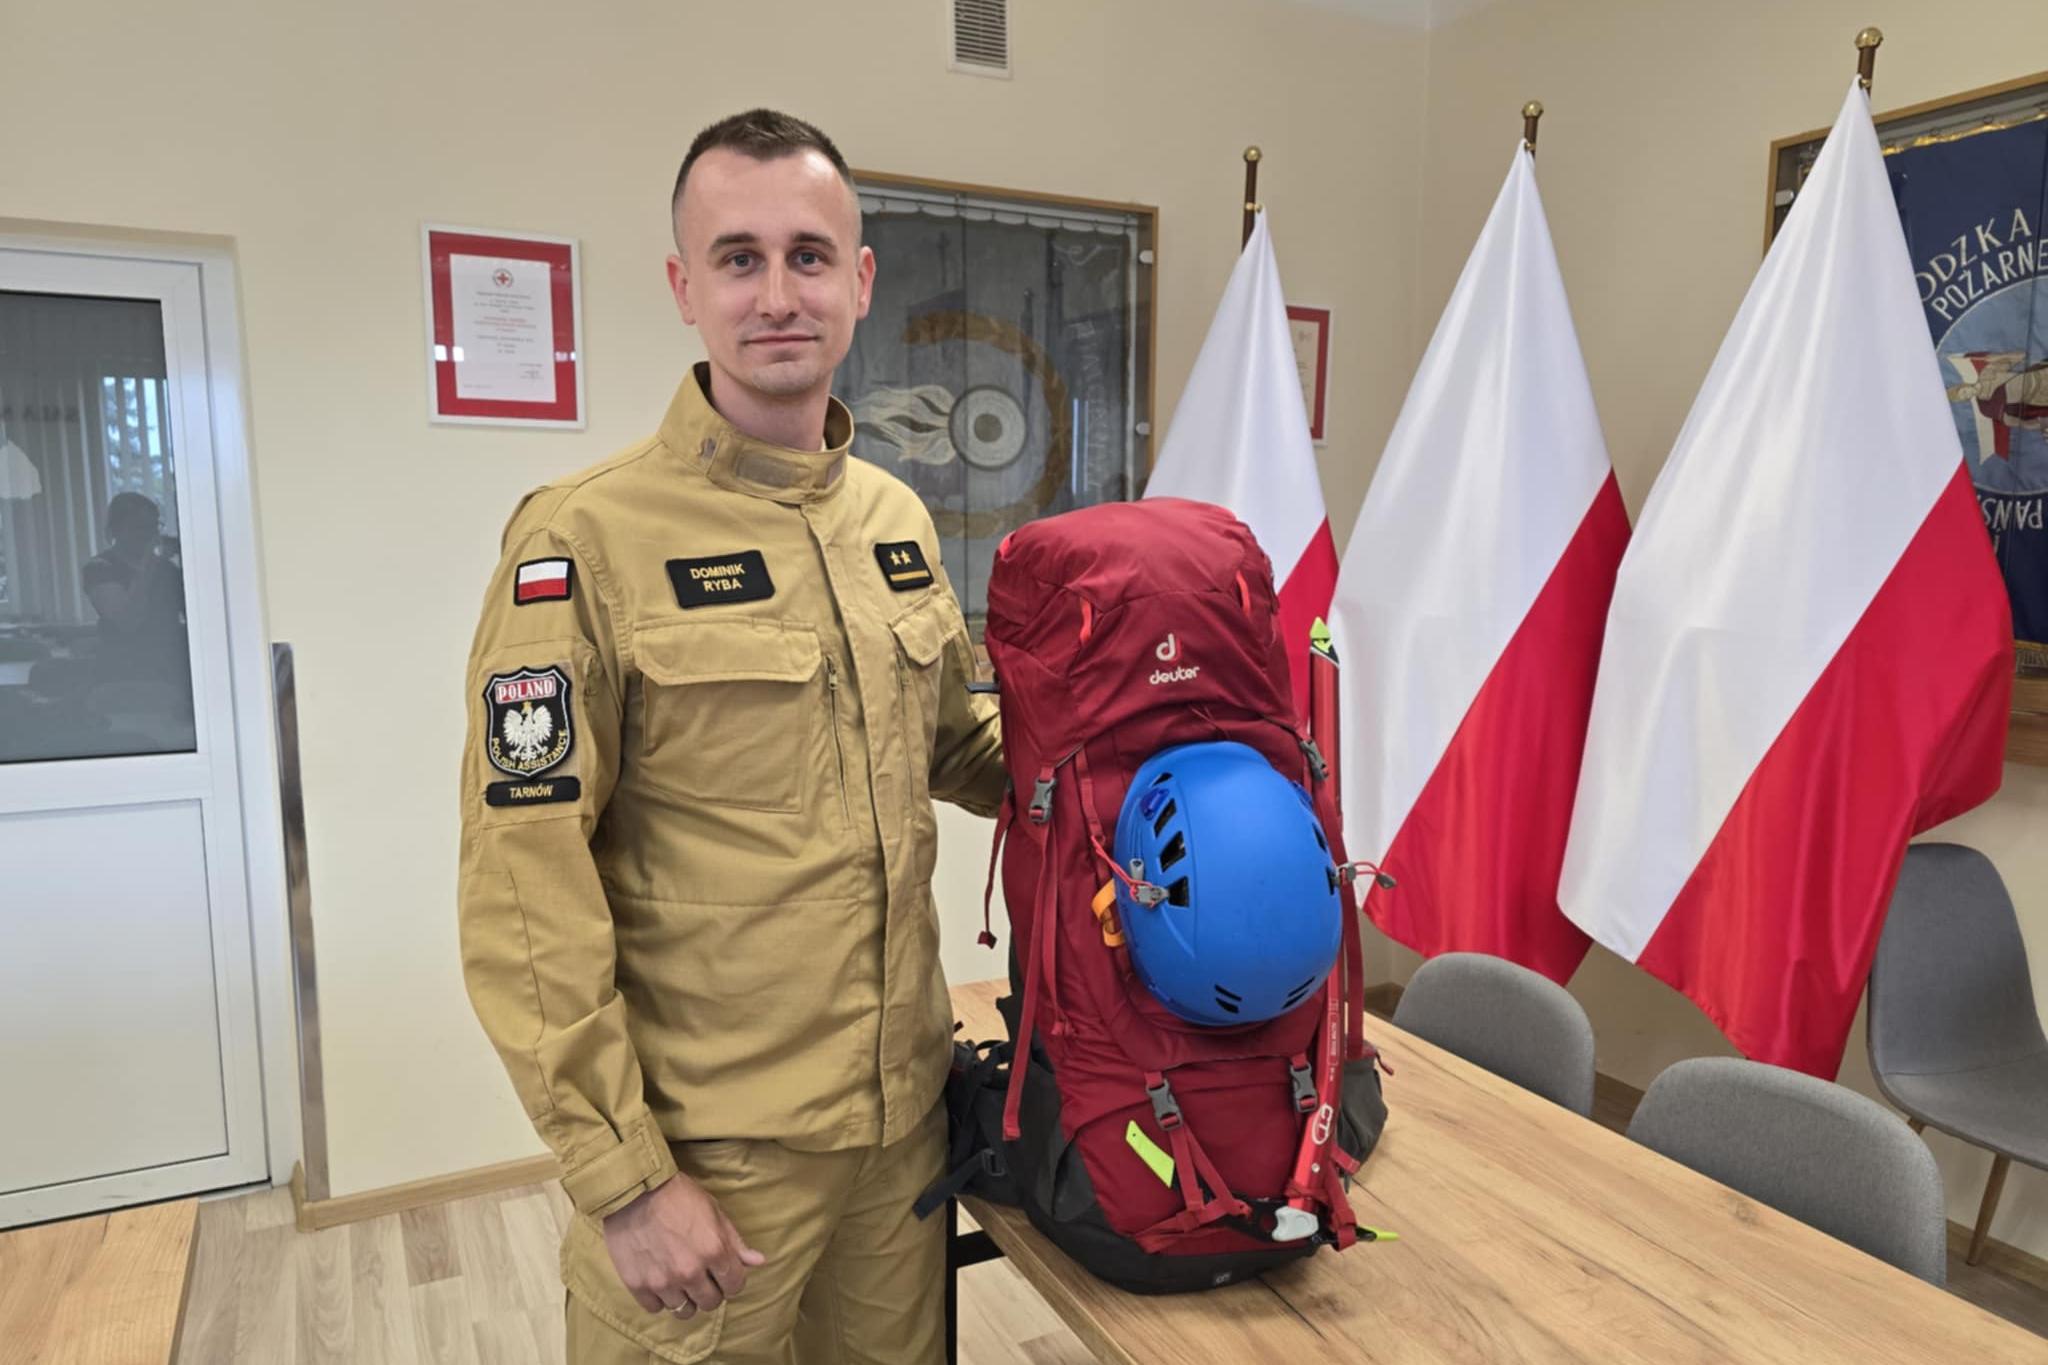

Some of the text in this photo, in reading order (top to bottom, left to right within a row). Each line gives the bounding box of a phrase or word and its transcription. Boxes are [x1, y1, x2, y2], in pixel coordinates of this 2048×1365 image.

[1978, 494, 2043, 533] PAŃS
[689, 563, 746, 579] DOMINIK
[703, 578, 743, 592] RYBA
[1149, 666, 1200, 685] deuter
[497, 680, 554, 701] POLAND
[518, 729, 567, 770] ASSISTANCE
[509, 783, 554, 799] TARNÓW
